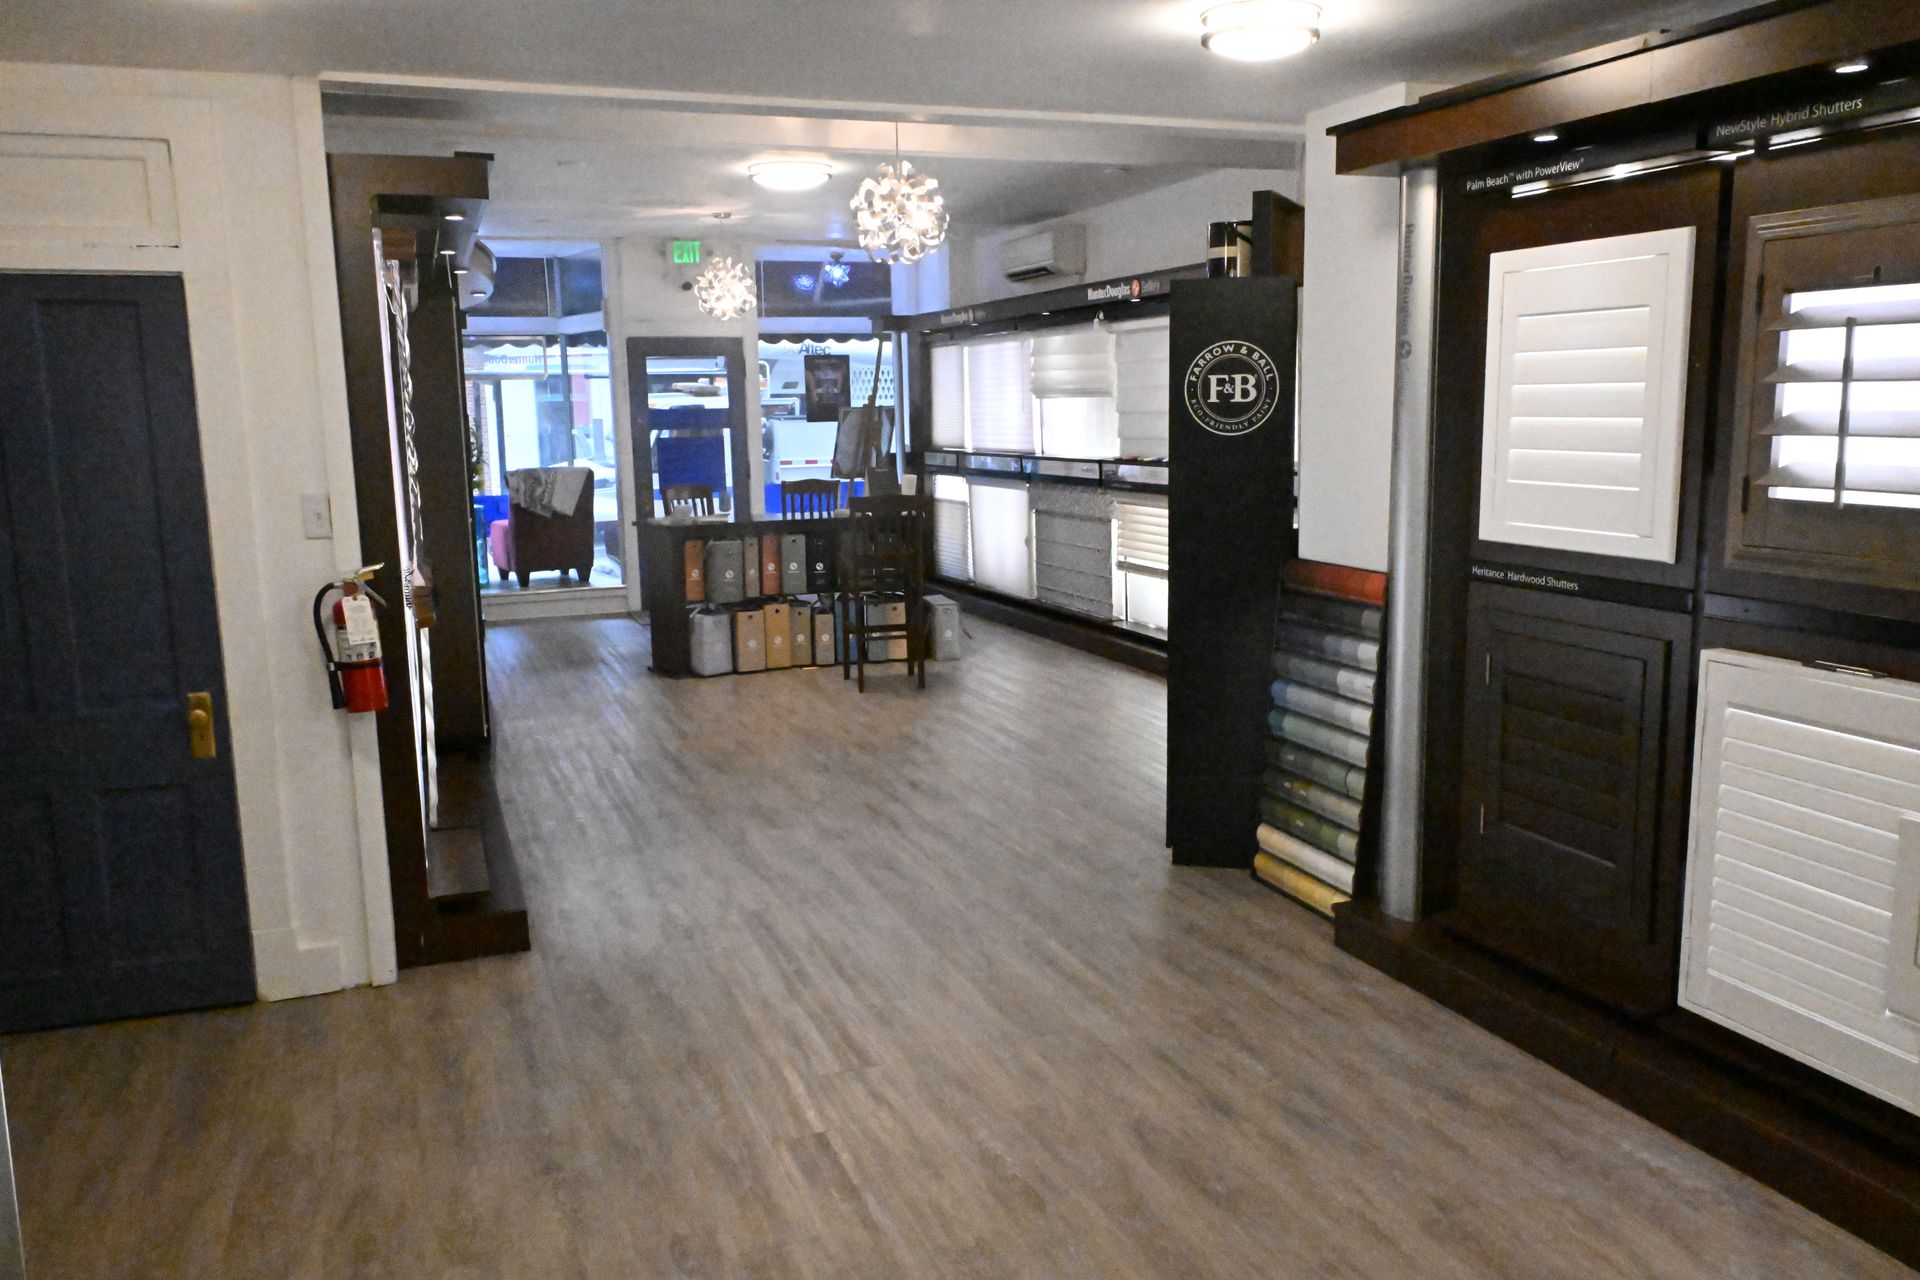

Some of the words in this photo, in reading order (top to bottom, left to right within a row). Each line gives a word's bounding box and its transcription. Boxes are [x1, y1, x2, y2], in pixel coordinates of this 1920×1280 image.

[1716, 116, 1767, 137] NewStyle
[1771, 107, 1810, 128] Hybrid
[1813, 98, 1863, 119] Shutters
[1466, 180, 1485, 191] Palm
[1516, 169, 1533, 181] with
[673, 241, 701, 264] EXIT
[798, 343, 831, 355] Altec
[1190, 344, 1235, 382] FARROW
[1240, 346, 1248, 354] &
[1251, 352, 1275, 381] BALL
[1191, 398, 1249, 431] ECO-FRIENDLY
[1252, 398, 1272, 423] PAINT
[1472, 564, 1505, 580] Heritance
[1508, 571, 1546, 586] Hardwood
[1547, 576, 1579, 591] Shutters
